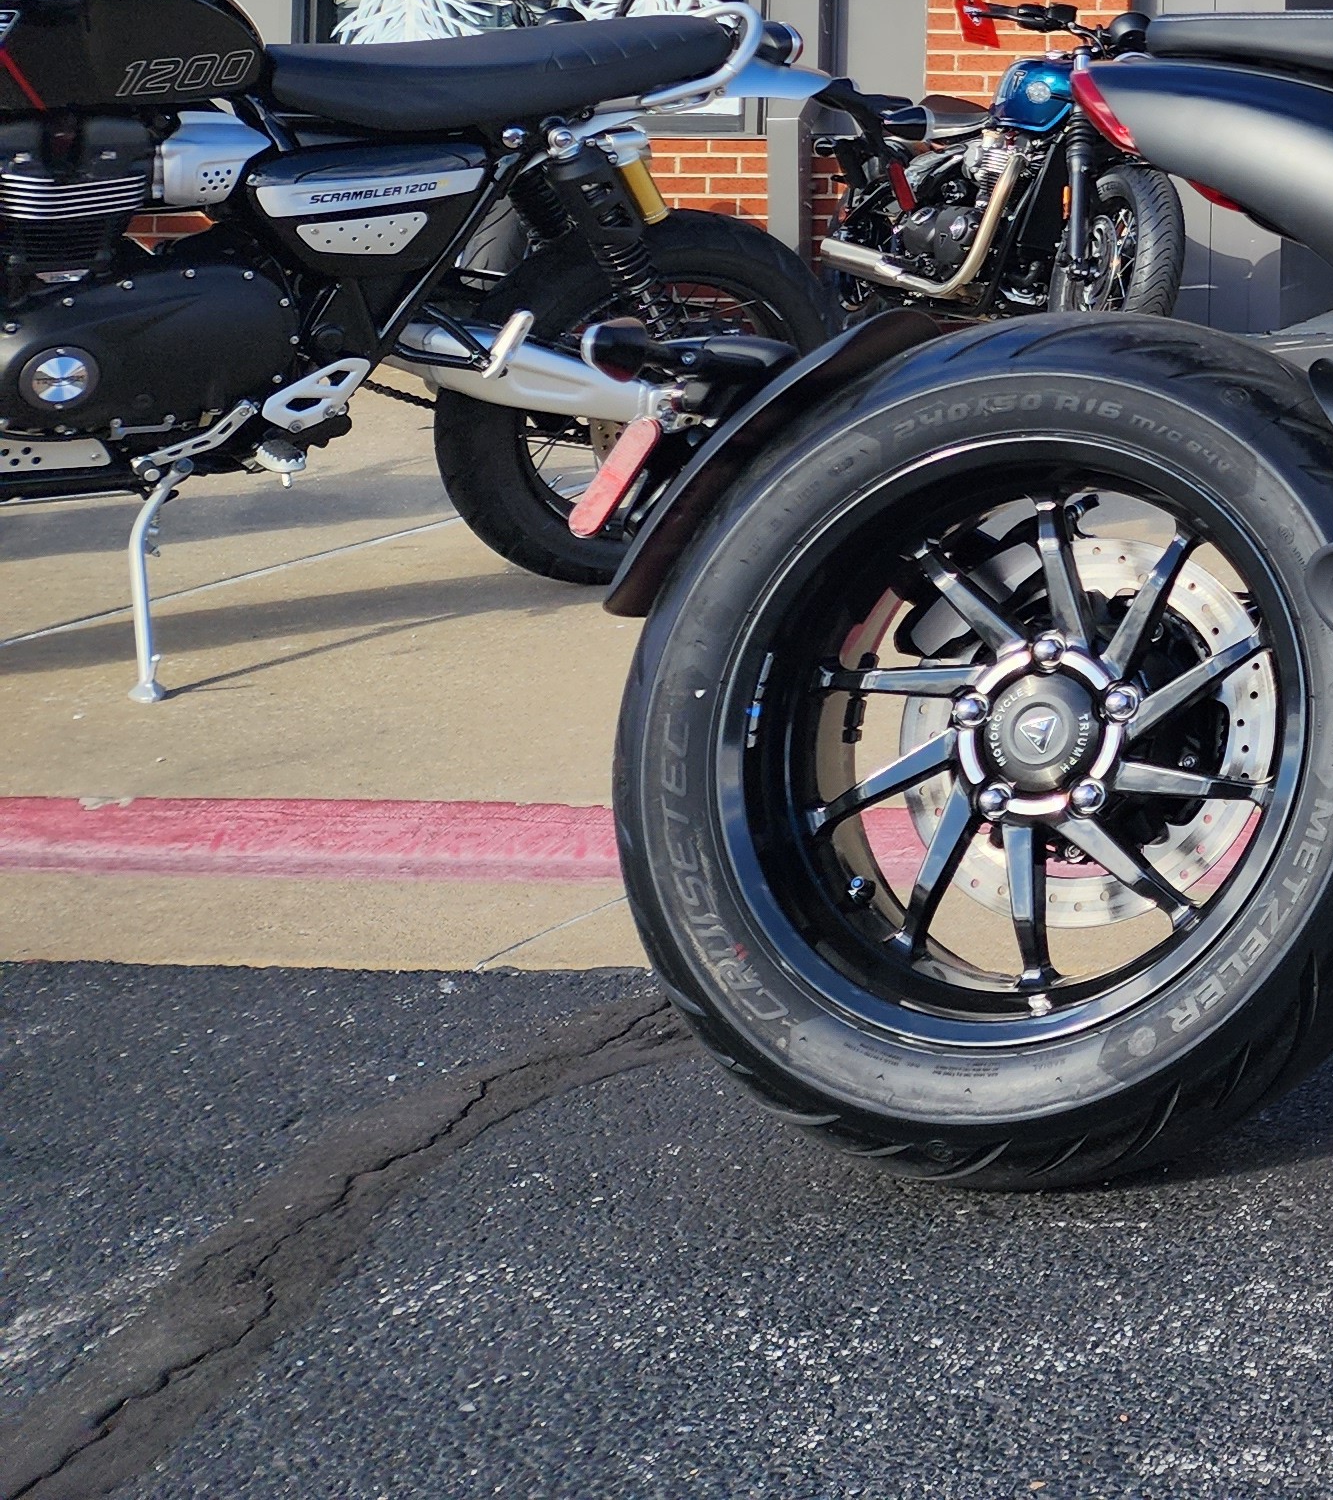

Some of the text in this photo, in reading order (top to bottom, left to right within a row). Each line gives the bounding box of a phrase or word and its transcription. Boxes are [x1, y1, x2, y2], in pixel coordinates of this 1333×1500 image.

[115, 49, 255, 97] 1200
[309, 185, 402, 204] SCRAMBLER
[404, 181, 438, 195] 1200
[1054, 395, 1124, 420] R16
[1060, 713, 1091, 774] TRIUMPH
[660, 712, 790, 1022] CRUISETEC
